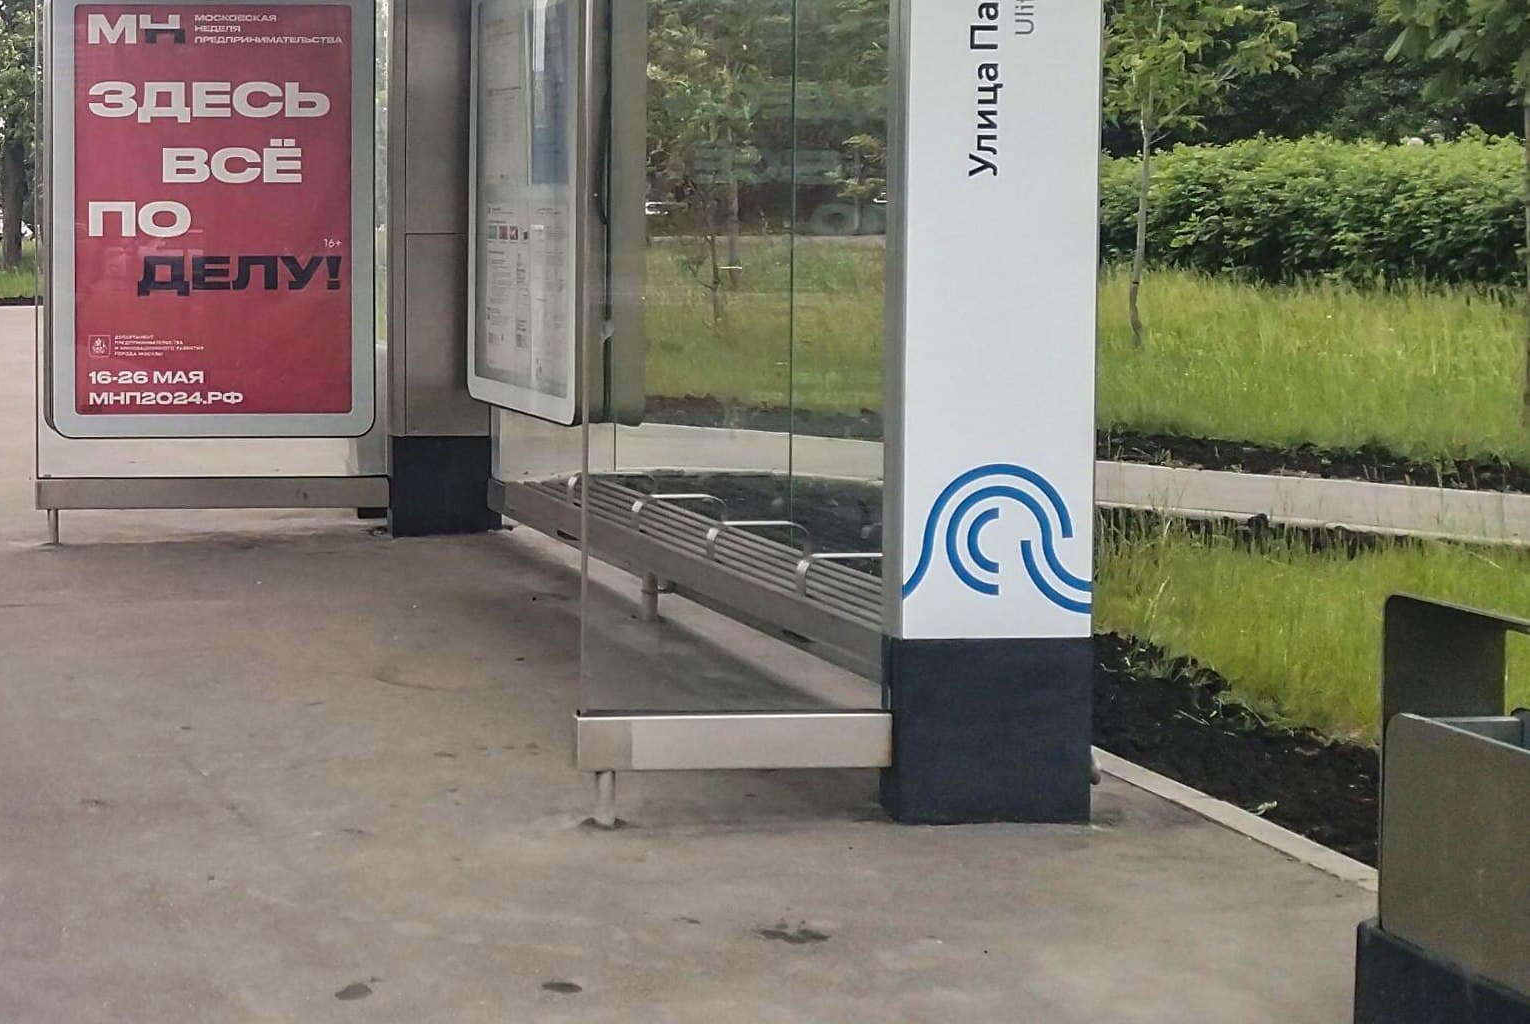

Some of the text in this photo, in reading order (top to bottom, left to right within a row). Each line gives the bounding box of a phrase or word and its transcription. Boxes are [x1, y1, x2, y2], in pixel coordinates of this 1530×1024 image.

[194, 14, 277, 22] МОСКОВСКАЯ
[194, 25, 241, 33] НЕДЕЛЯ
[194, 36, 343, 44] ПРЕДПРИНИМАТЕЛЬСТВА
[88, 81, 331, 123] ЗДЕСЬ
[968, 62, 1004, 177] Улица
[162, 138, 303, 183] ВСЁ
[88, 200, 192, 238] ПО
[323, 238, 343, 248] 16+
[137, 255, 343, 297] ДЕЛУ!
[88, 371, 205, 384] 16-26 МАЯ
[88, 392, 244, 405] МНП2024.РФ
